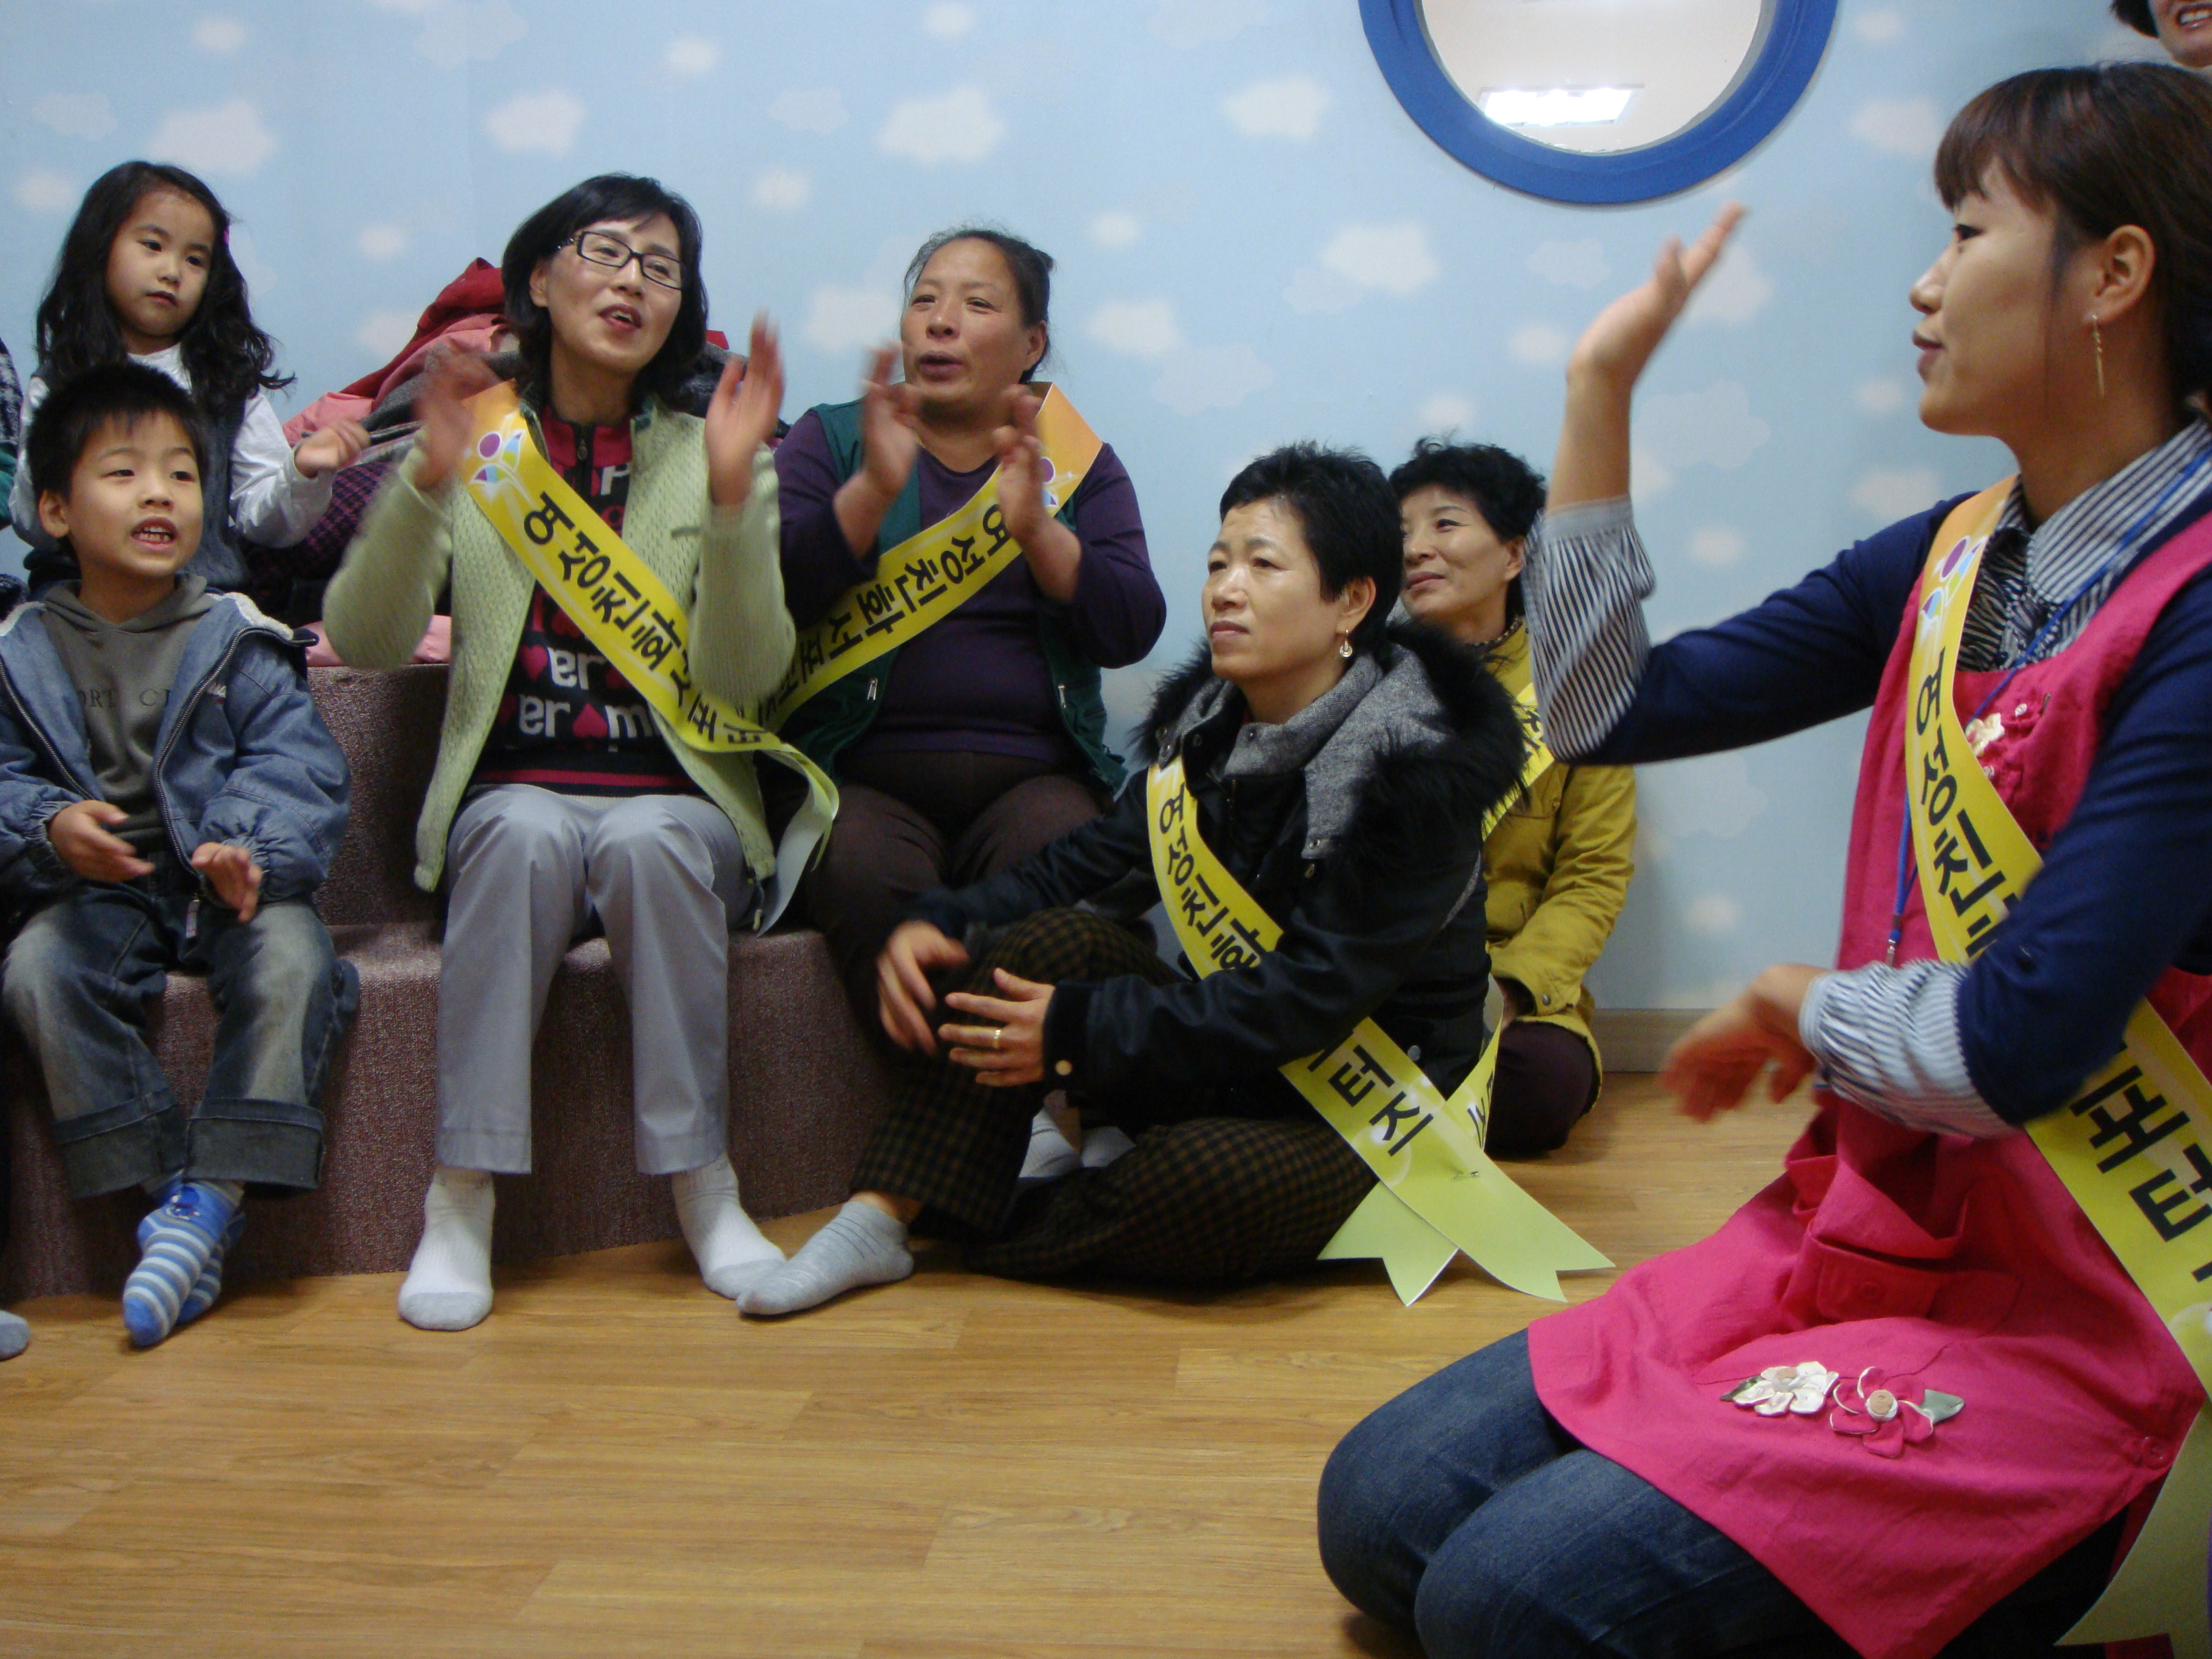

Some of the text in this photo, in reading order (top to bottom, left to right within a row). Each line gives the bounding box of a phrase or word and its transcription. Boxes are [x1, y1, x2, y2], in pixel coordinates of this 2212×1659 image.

[524, 490, 768, 743] 여성친화 서포터
[857, 503, 1010, 634] 여성친화
[1308, 1043, 1435, 1157] 터즈
